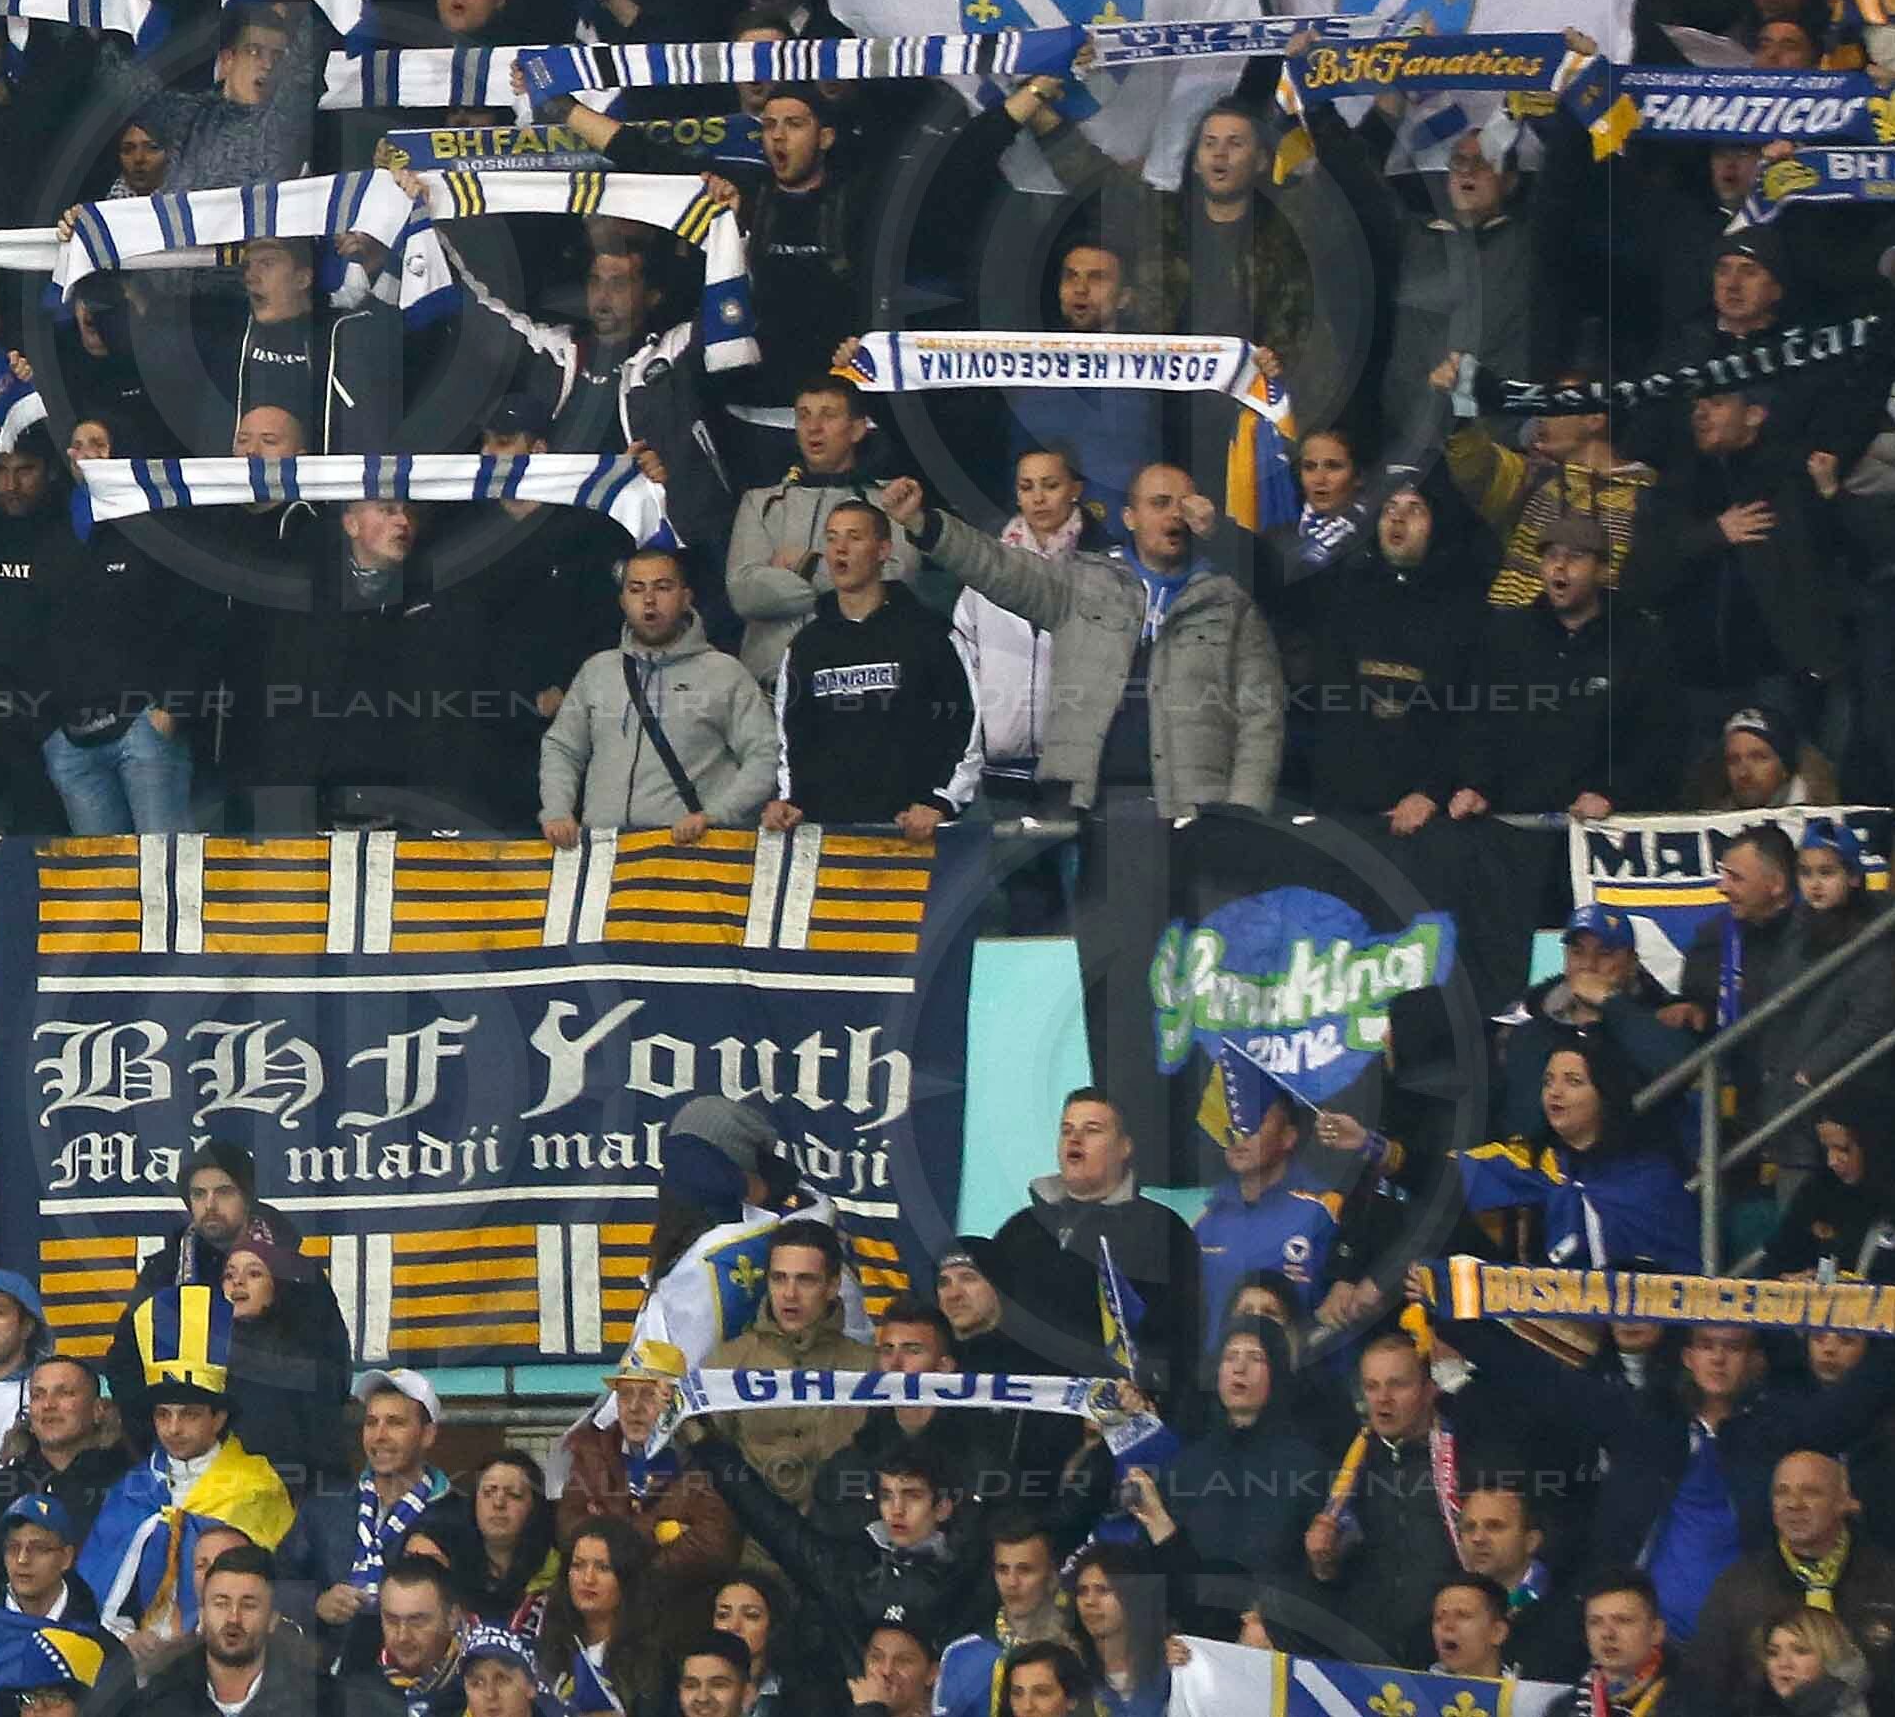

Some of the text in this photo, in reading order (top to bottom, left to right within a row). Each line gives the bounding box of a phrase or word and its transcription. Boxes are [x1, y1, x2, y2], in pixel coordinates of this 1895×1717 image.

[1305, 42, 1544, 89] BHFanaticos
[1641, 95, 1858, 133] FANATICOS
[430, 113, 727, 161] BH FANACOS
[1827, 153, 1886, 179] BH
[918, 350, 1108, 381] HERCEGOVINA
[1130, 353, 1219, 382] BOSNA
[519, 997, 917, 1132] Youth
[286, 1122, 501, 1187] mladji
[530, 1120, 666, 1174] mal
[1483, 1265, 1610, 1316] BOSNA
[1633, 1271, 1895, 1335] HERCEGOVINA
[732, 1368, 1034, 1404] GAZIJE
